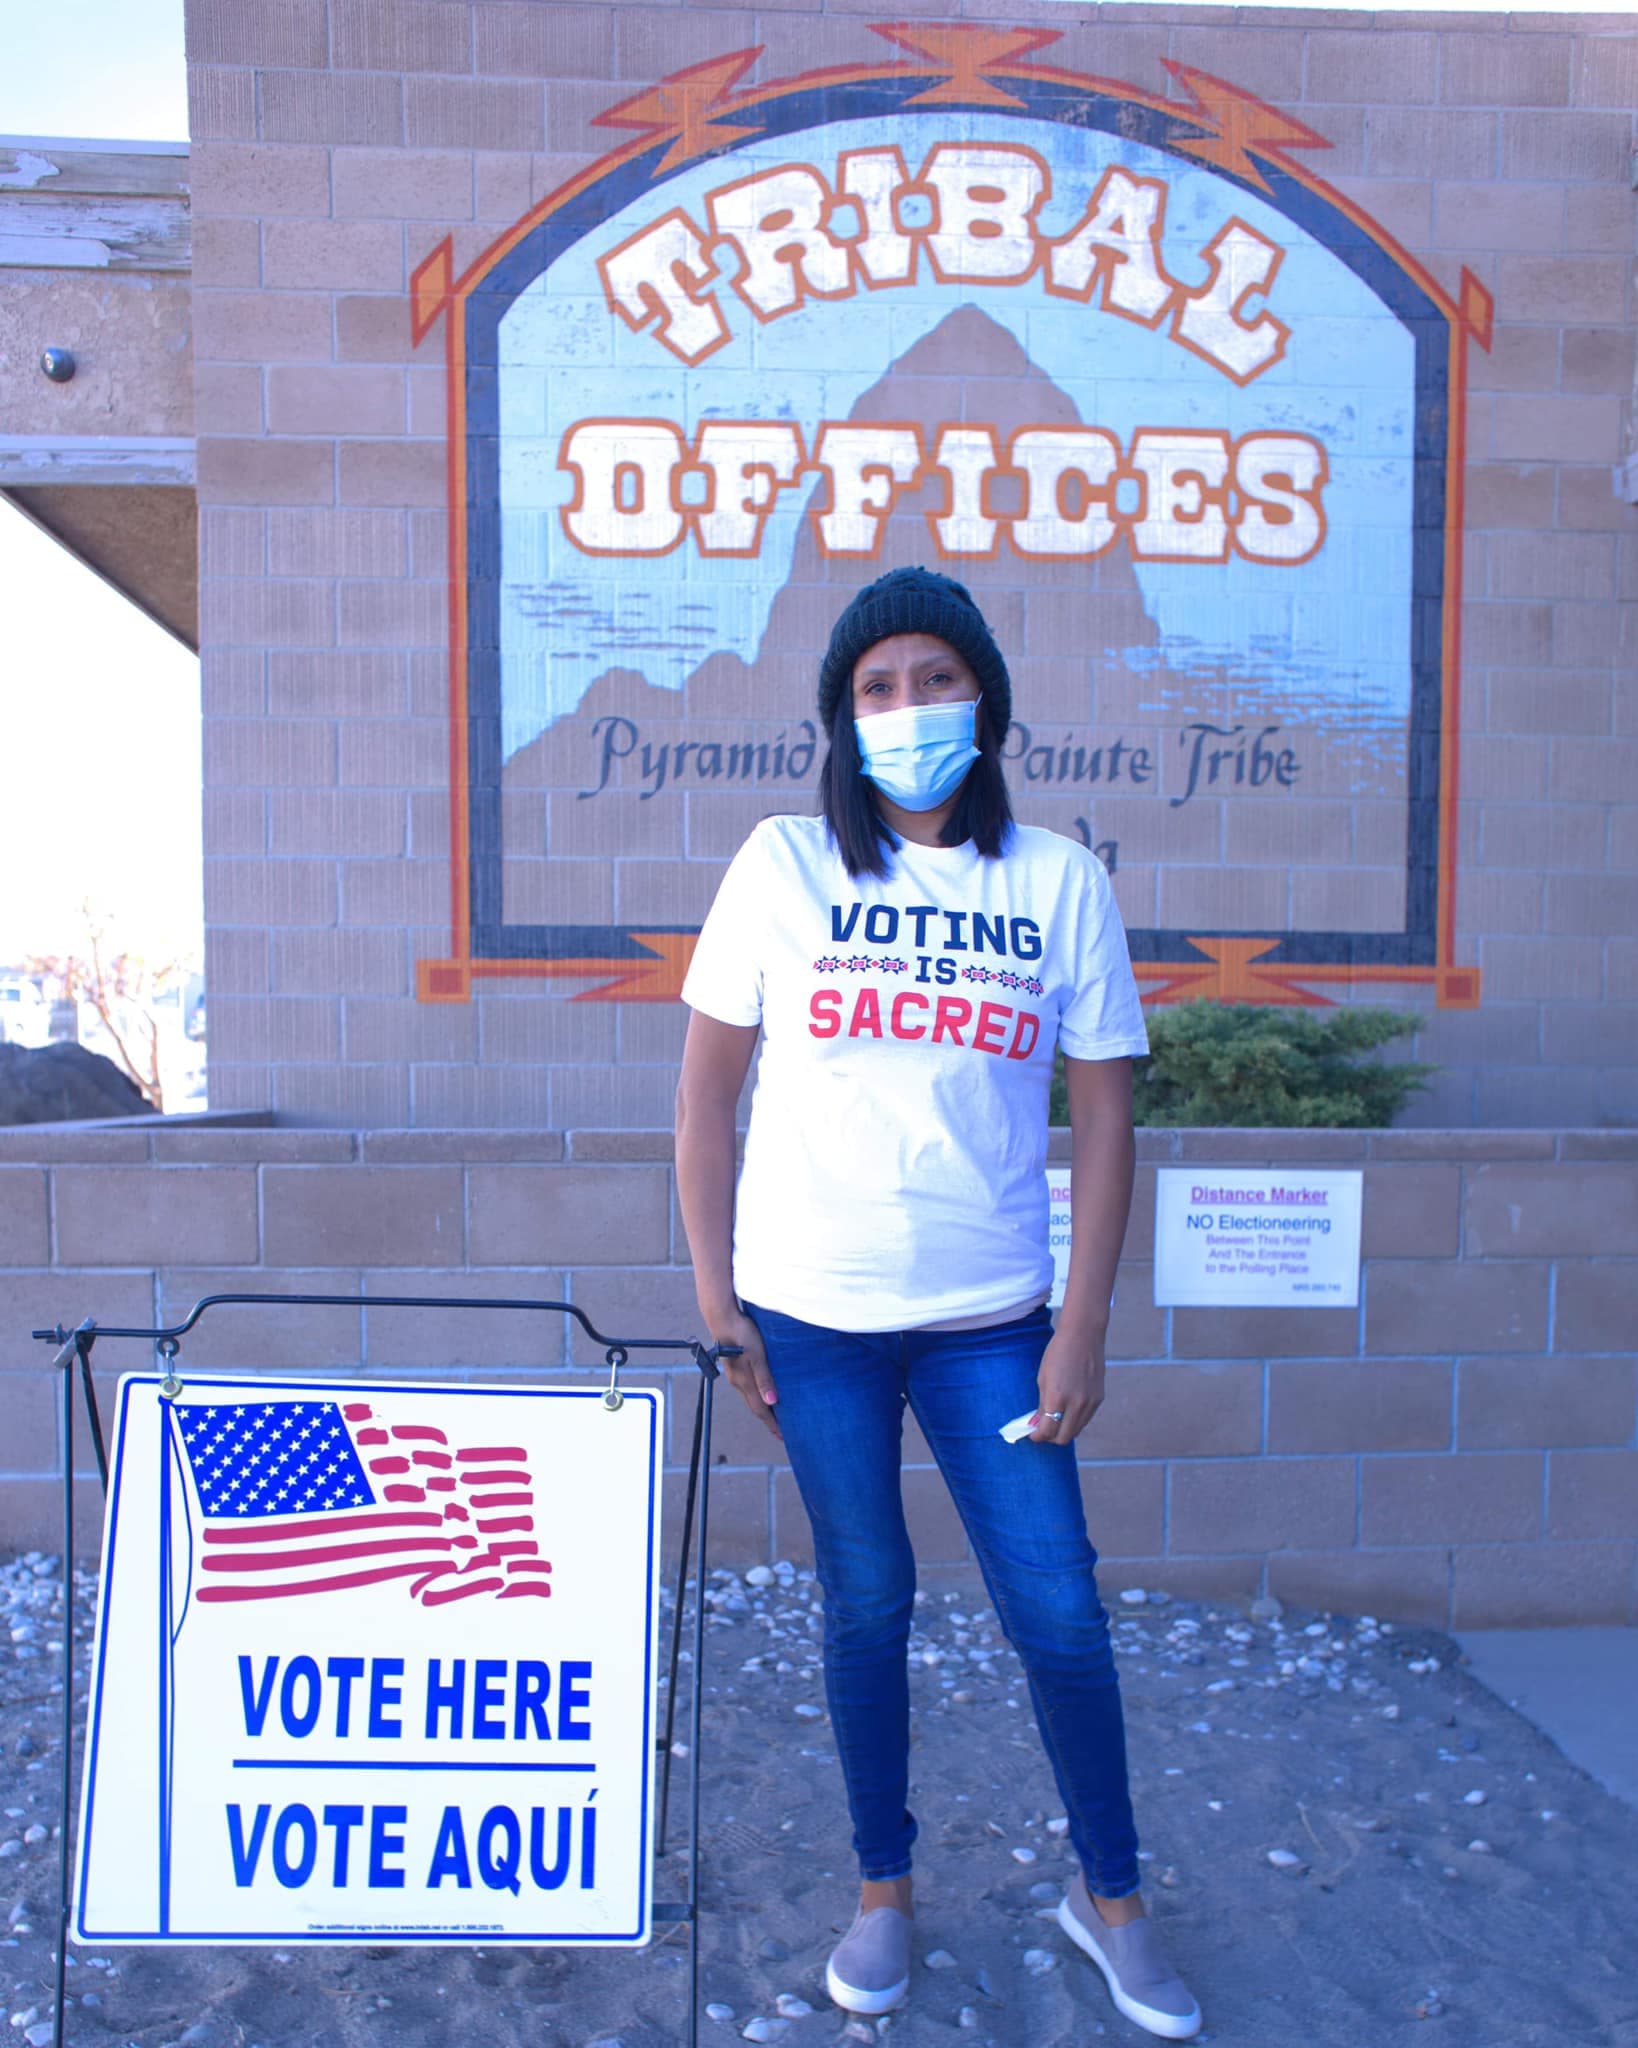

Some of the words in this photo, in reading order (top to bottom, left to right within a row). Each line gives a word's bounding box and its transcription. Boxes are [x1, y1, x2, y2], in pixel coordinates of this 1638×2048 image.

[596, 141, 1291, 387] TRIBAL
[558, 416, 1330, 566] OFFICES
[577, 716, 817, 800] Pyramid
[1169, 723, 1302, 807] Tribe
[831, 902, 1042, 961] VOTING
[915, 956, 957, 985] IS
[808, 988, 1040, 1061] SACRED
[1187, 1214, 1214, 1230] NO
[1218, 1214, 1331, 1233] Electioneering
[1191, 1186, 1266, 1203] Distance
[1271, 1187, 1328, 1204] Marker
[1206, 1234, 1254, 1245] Between
[1257, 1234, 1280, 1246] This
[1208, 1249, 1232, 1260] And
[238, 1655, 405, 1738] VOTE
[425, 1658, 592, 1740] HERE
[226, 1803, 407, 1888] VOTE
[426, 1789, 598, 1897] AQUÍ
